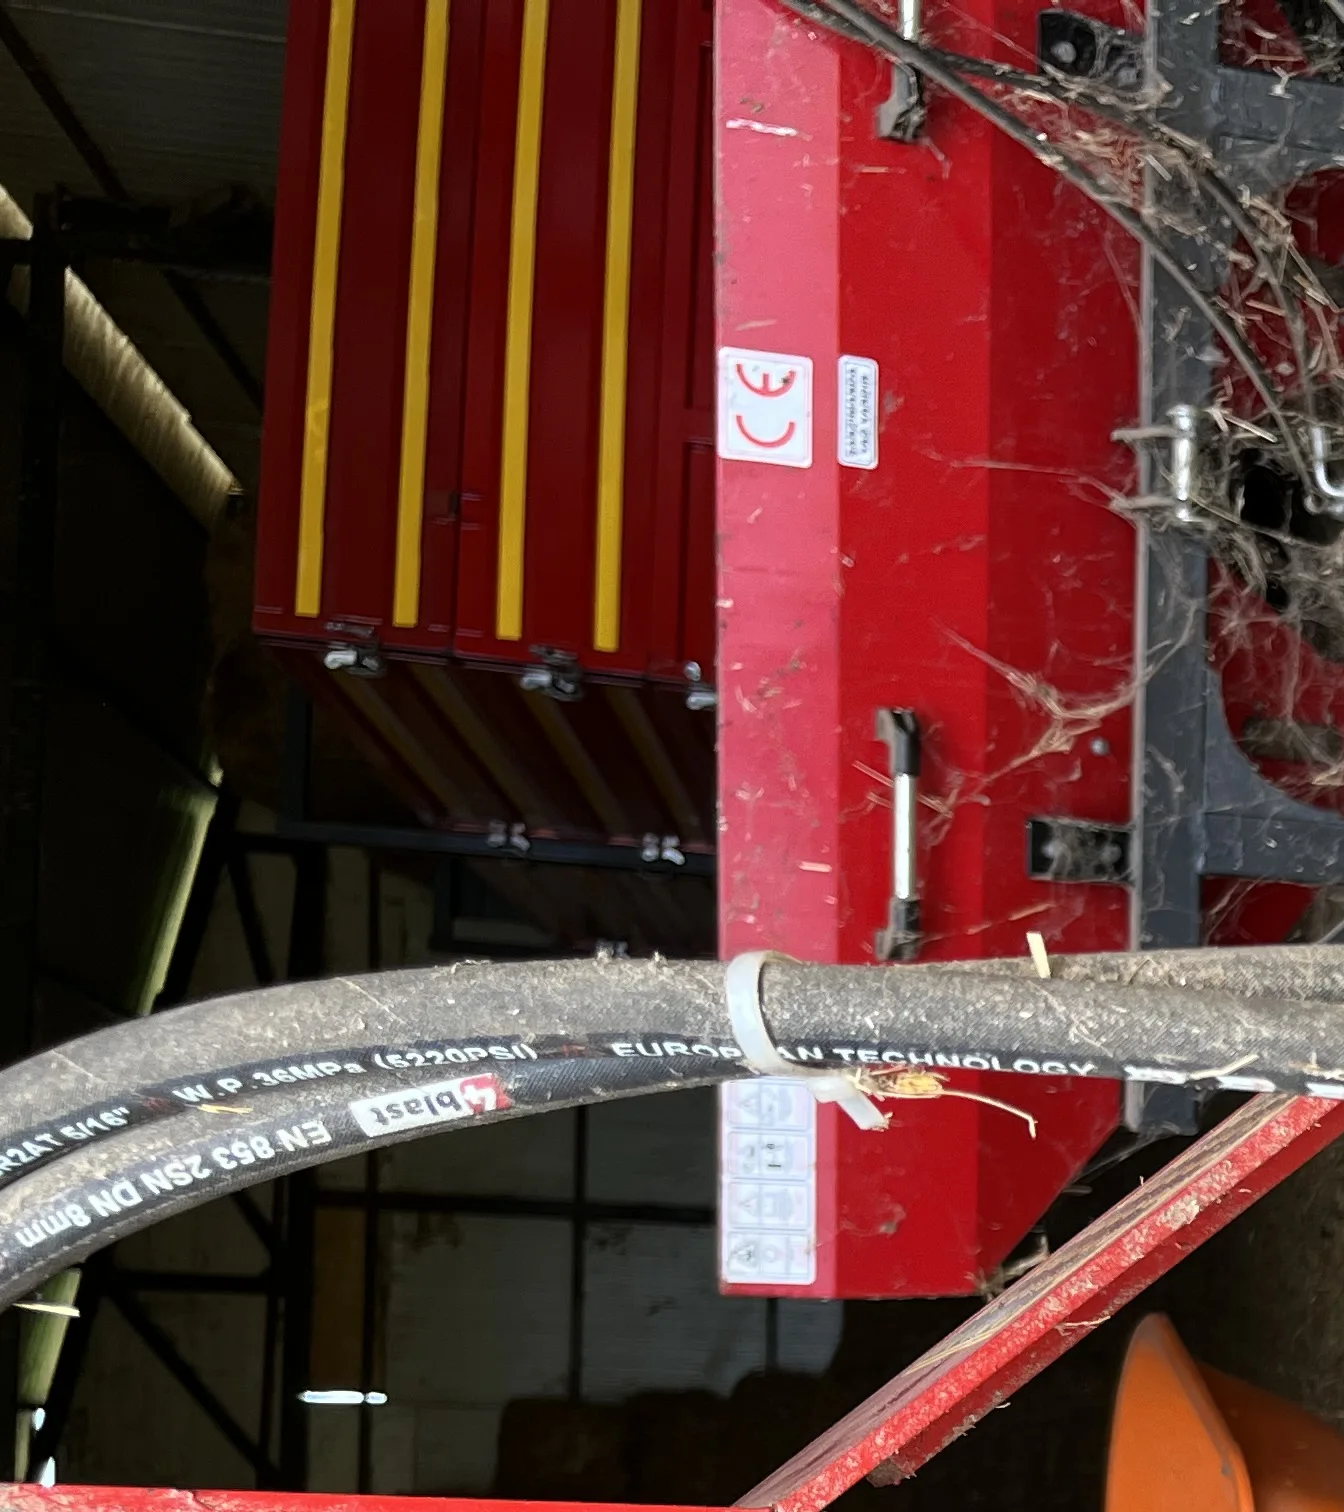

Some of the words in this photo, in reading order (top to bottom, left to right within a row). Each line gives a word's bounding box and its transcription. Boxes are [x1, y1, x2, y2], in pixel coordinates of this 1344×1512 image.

[373, 1043, 538, 1070] (5220PSI)
[611, 1042, 824, 1062] EUROPAN
[832, 1048, 1096, 1078] TECHNOLOGY
[212, 1136, 276, 1170] 853
[276, 1120, 332, 1153] EN
[140, 1154, 211, 1195] 2SN
[88, 1177, 143, 1217] DN
[15, 1203, 91, 1247] 8mm
